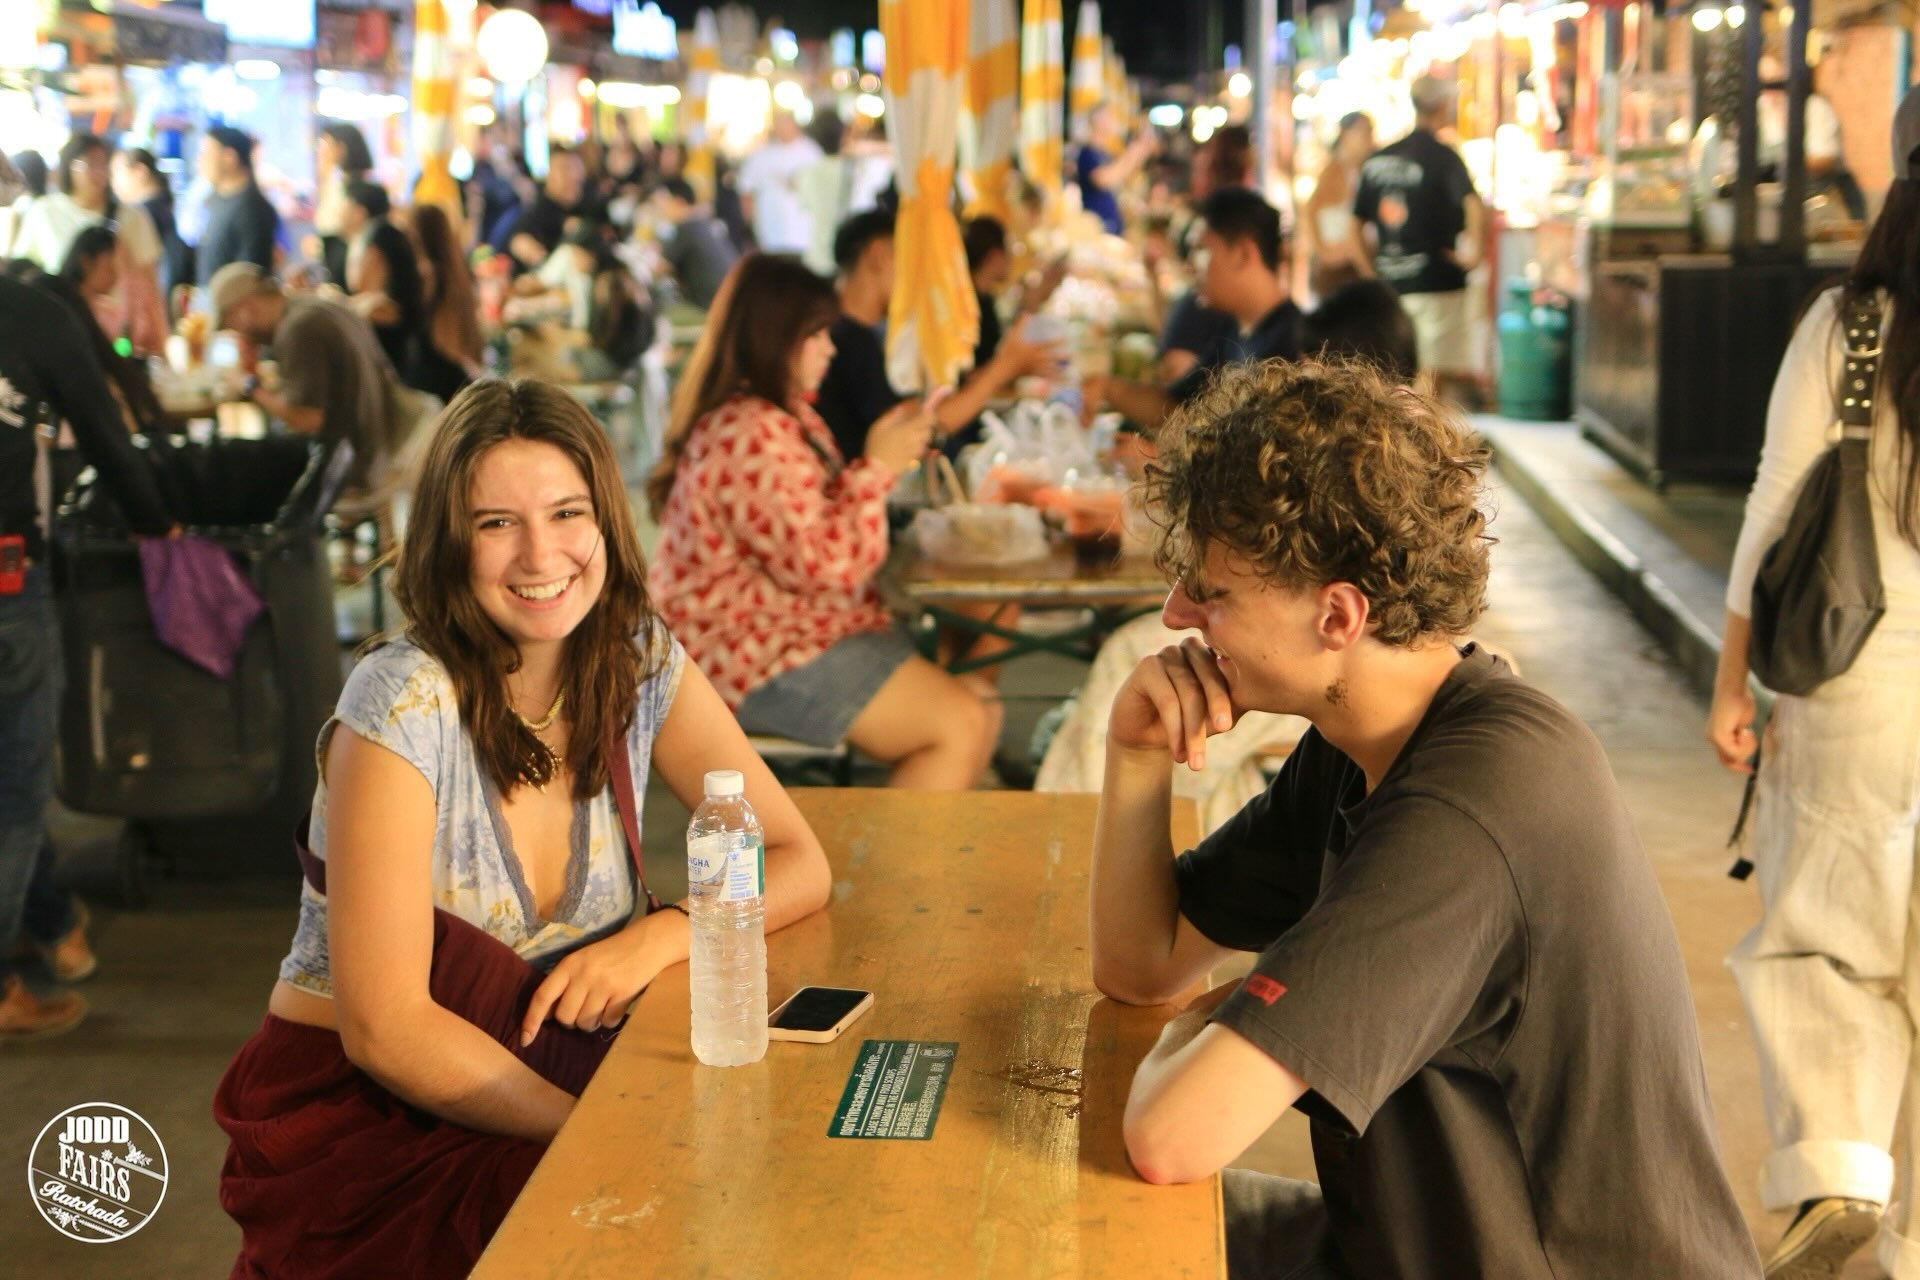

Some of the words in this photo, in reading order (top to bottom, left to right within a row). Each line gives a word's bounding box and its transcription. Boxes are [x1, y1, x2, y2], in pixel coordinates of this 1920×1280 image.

[884, 1068, 897, 1083] SCRAPS
[881, 1083, 891, 1093] FOOD
[871, 1105, 884, 1119] THROW
[864, 1119, 879, 1136] PLEASE
